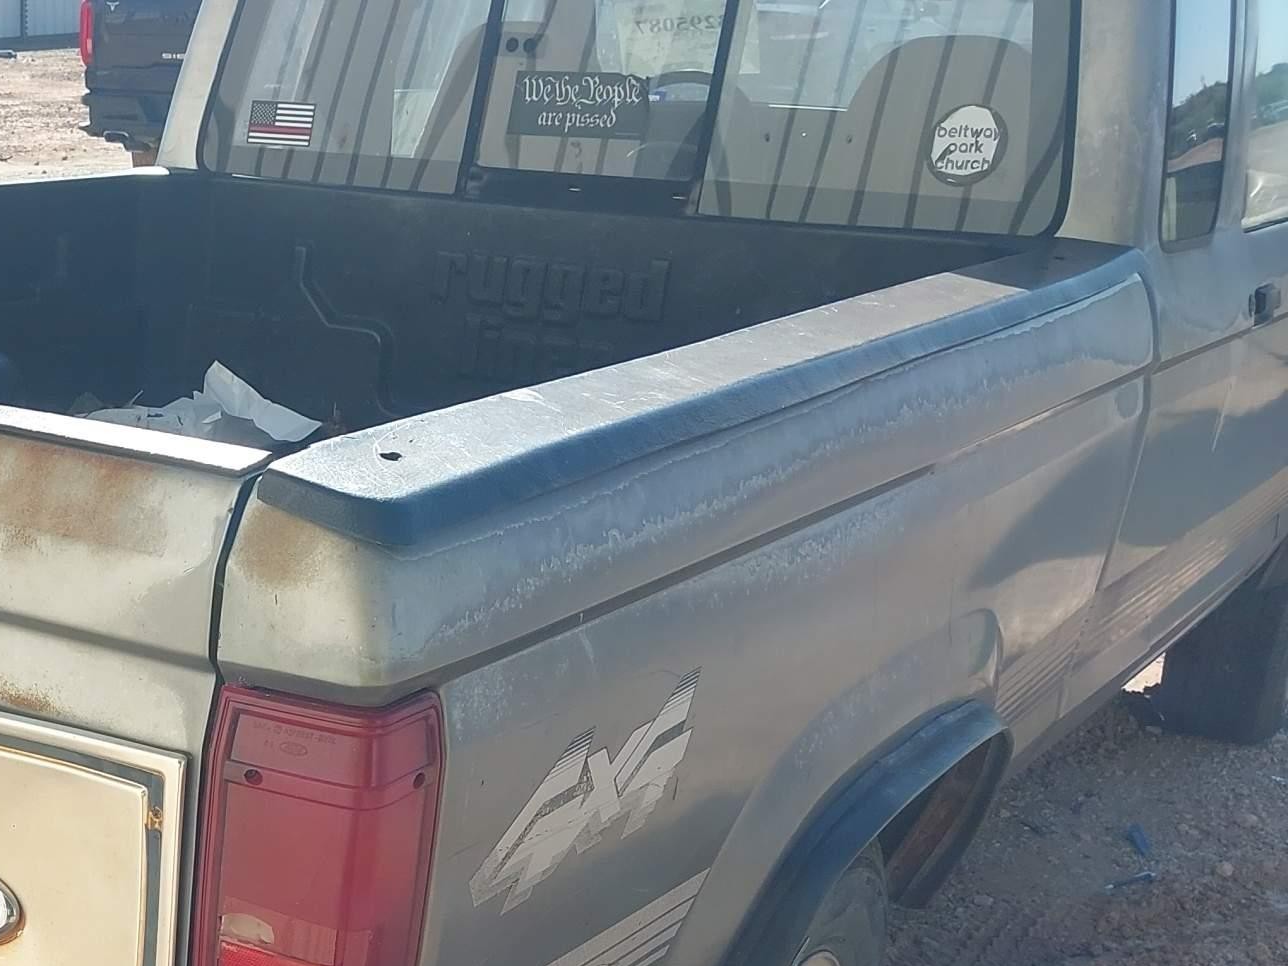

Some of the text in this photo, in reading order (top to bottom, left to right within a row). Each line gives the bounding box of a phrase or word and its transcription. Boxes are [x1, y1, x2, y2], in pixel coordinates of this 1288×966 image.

[523, 76, 553, 105] We
[575, 75, 642, 109] People
[537, 108, 616, 133] are pissed
[948, 137, 984, 155] park
[934, 157, 991, 171] church
[431, 250, 673, 326] rugged
